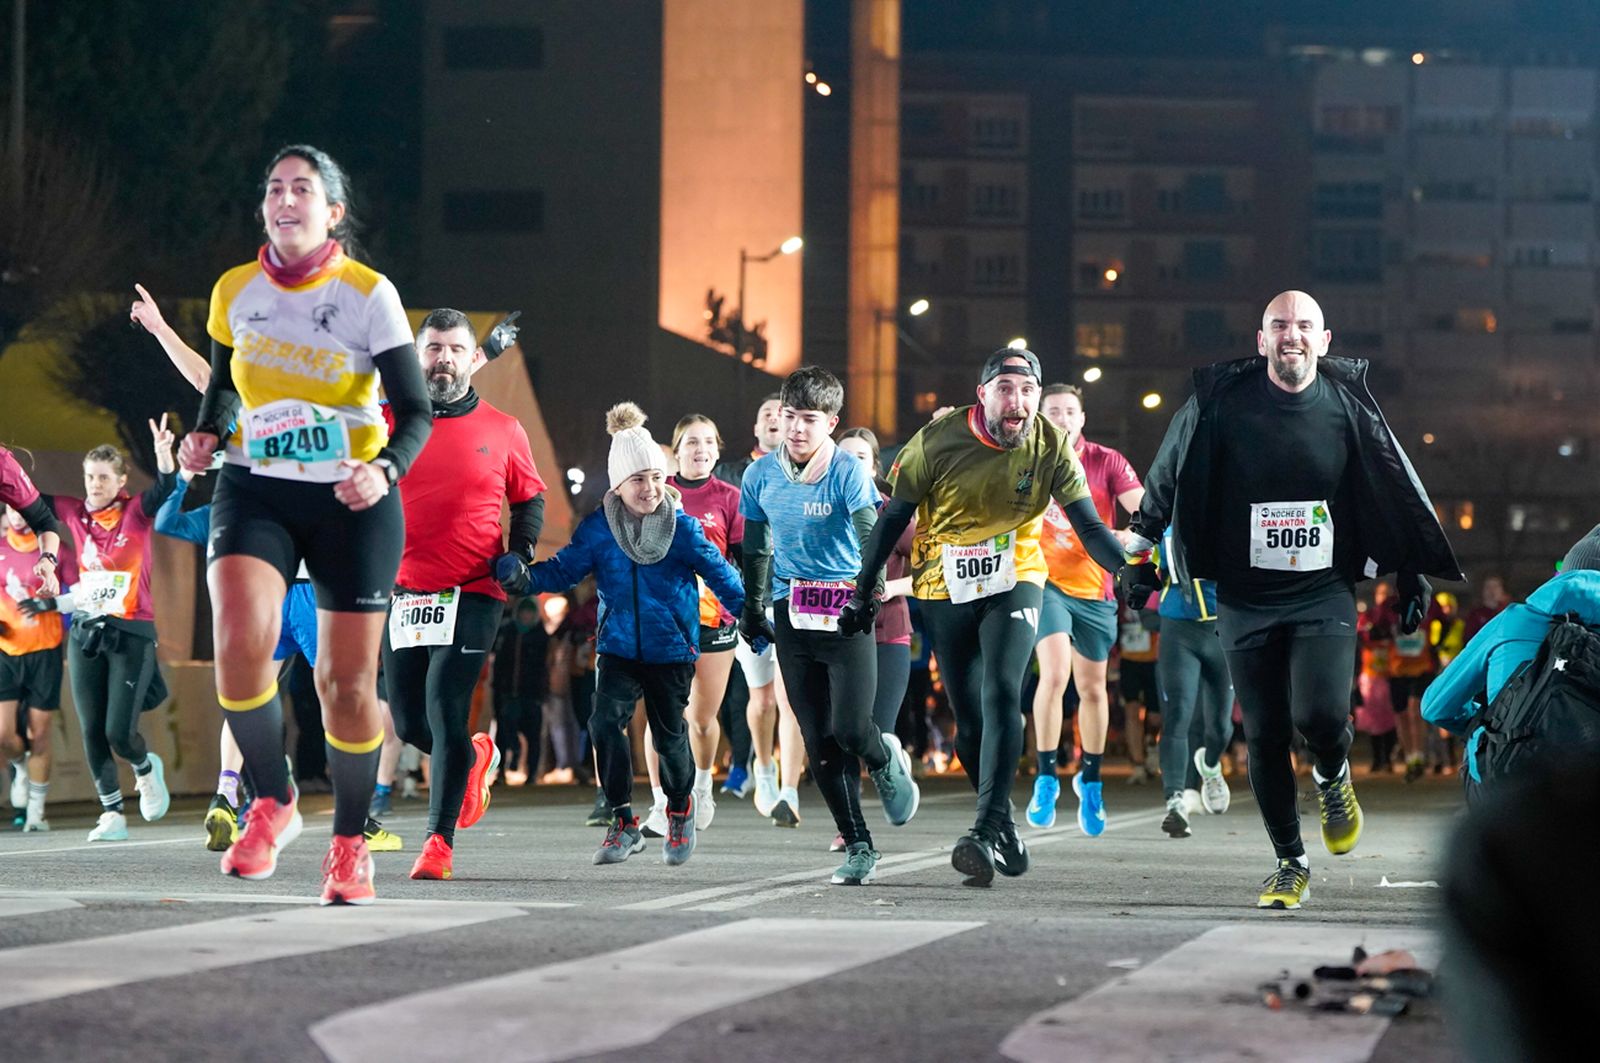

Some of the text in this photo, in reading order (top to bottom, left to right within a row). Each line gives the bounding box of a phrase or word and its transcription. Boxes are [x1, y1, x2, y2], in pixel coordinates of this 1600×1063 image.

[264, 409, 290, 423] NOCHE
[292, 407, 303, 417] DE
[255, 427, 274, 438] SAN
[264, 426, 329, 458] 8240
[1270, 510, 1295, 518] NOCHE
[1261, 520, 1278, 528] SAN
[1266, 526, 1321, 549] 5068
[956, 553, 1002, 579] 5067
[401, 605, 445, 627] 5066
